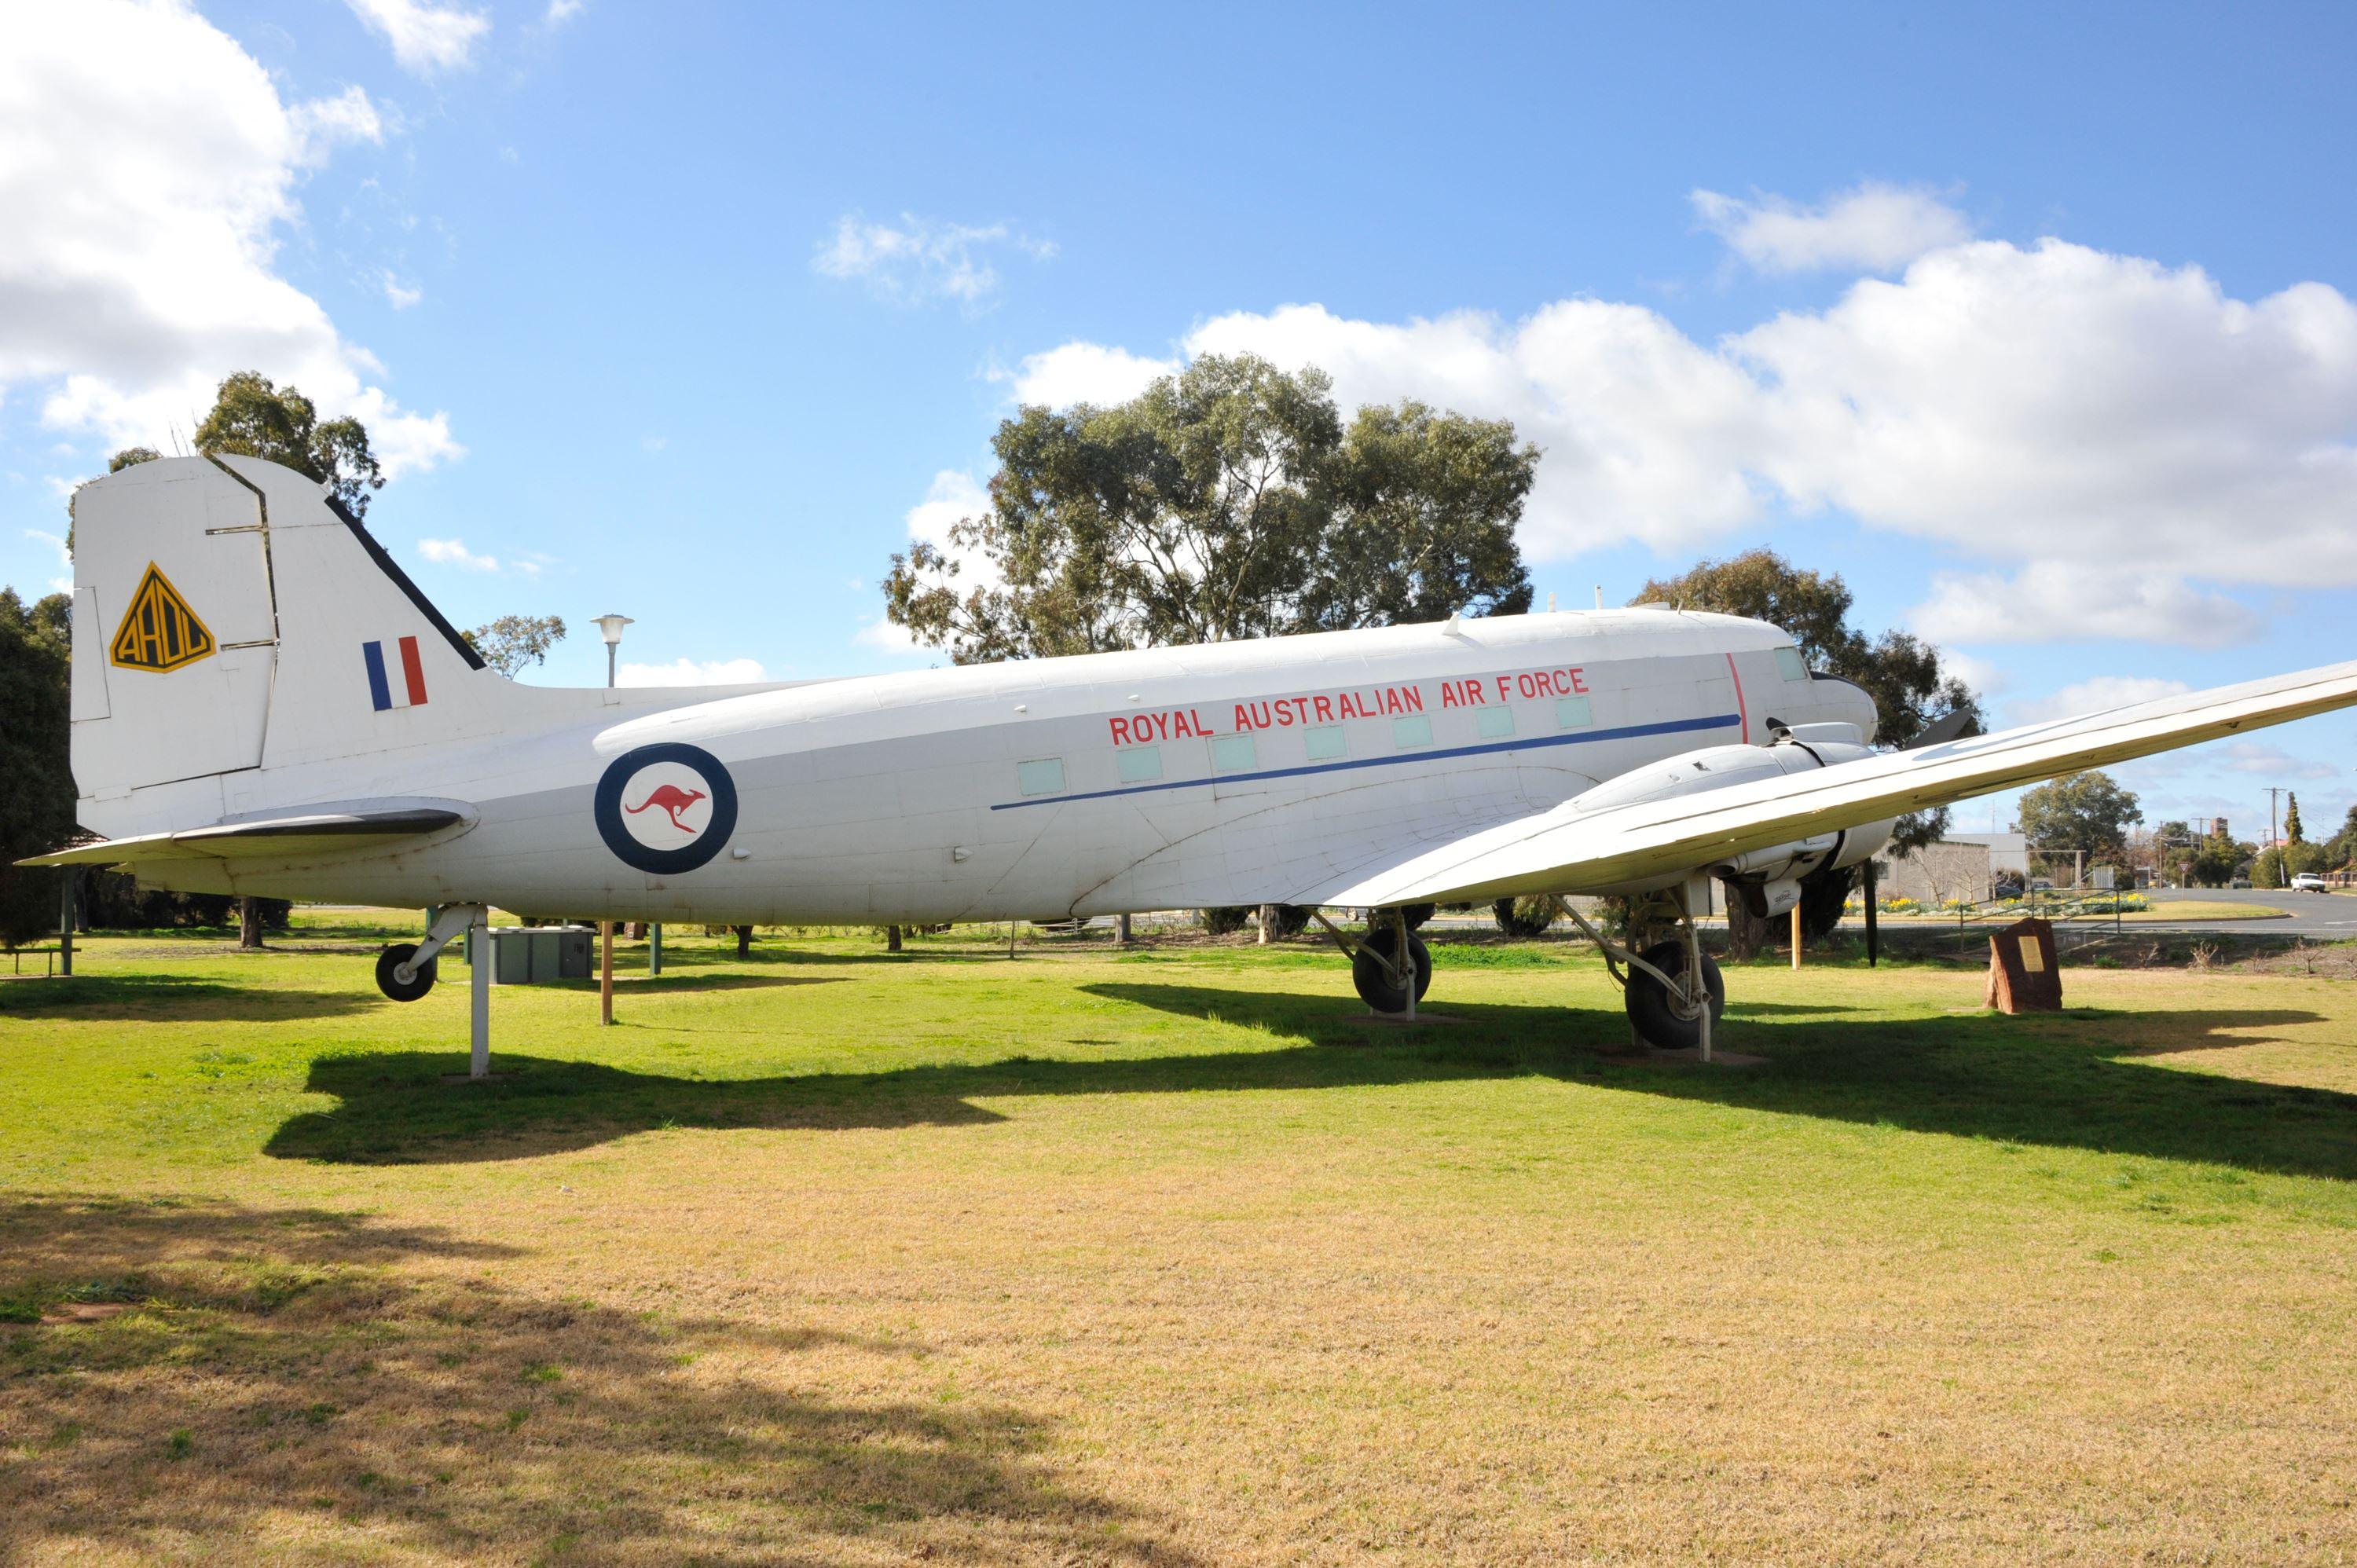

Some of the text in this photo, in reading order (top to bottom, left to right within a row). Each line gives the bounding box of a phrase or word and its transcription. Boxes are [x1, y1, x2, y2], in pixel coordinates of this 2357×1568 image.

[1109, 668, 1589, 746] ROYAL AUSTRALIAN AIR FORCE
